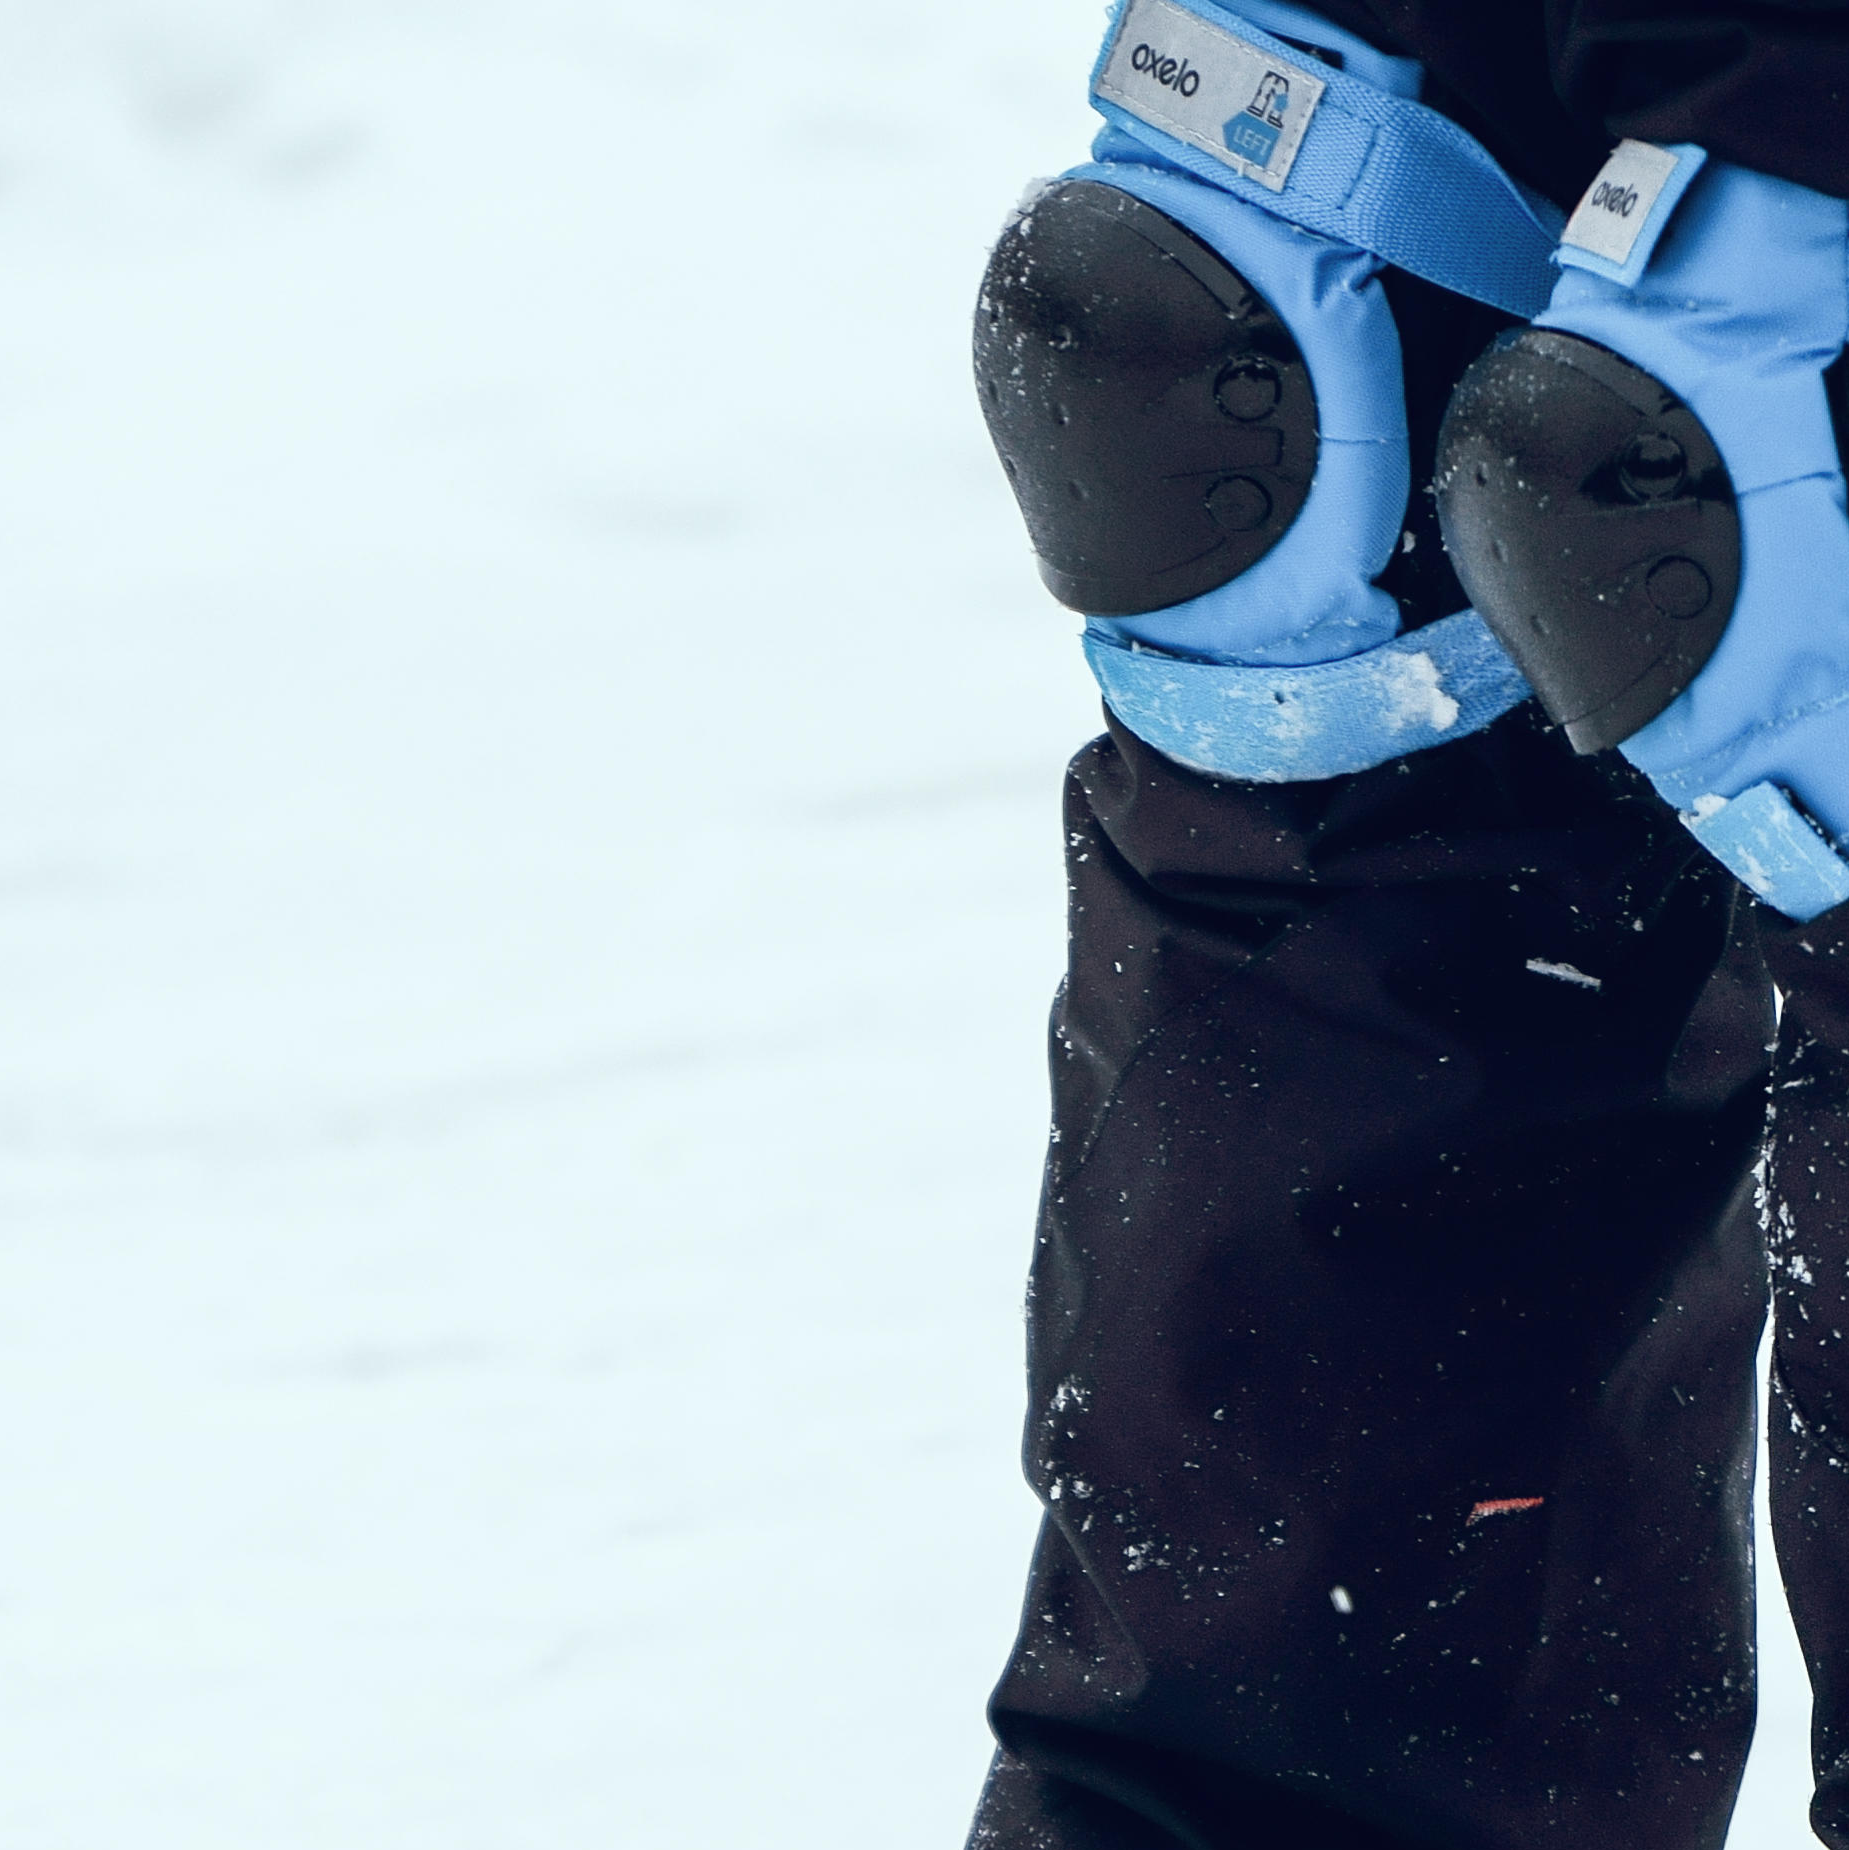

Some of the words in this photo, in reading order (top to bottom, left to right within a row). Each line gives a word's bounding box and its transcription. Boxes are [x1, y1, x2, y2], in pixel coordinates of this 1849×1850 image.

[1131, 43, 1200, 97] oxelo
[1233, 124, 1272, 157] LEFT
[1591, 180, 1639, 218] oxelo
